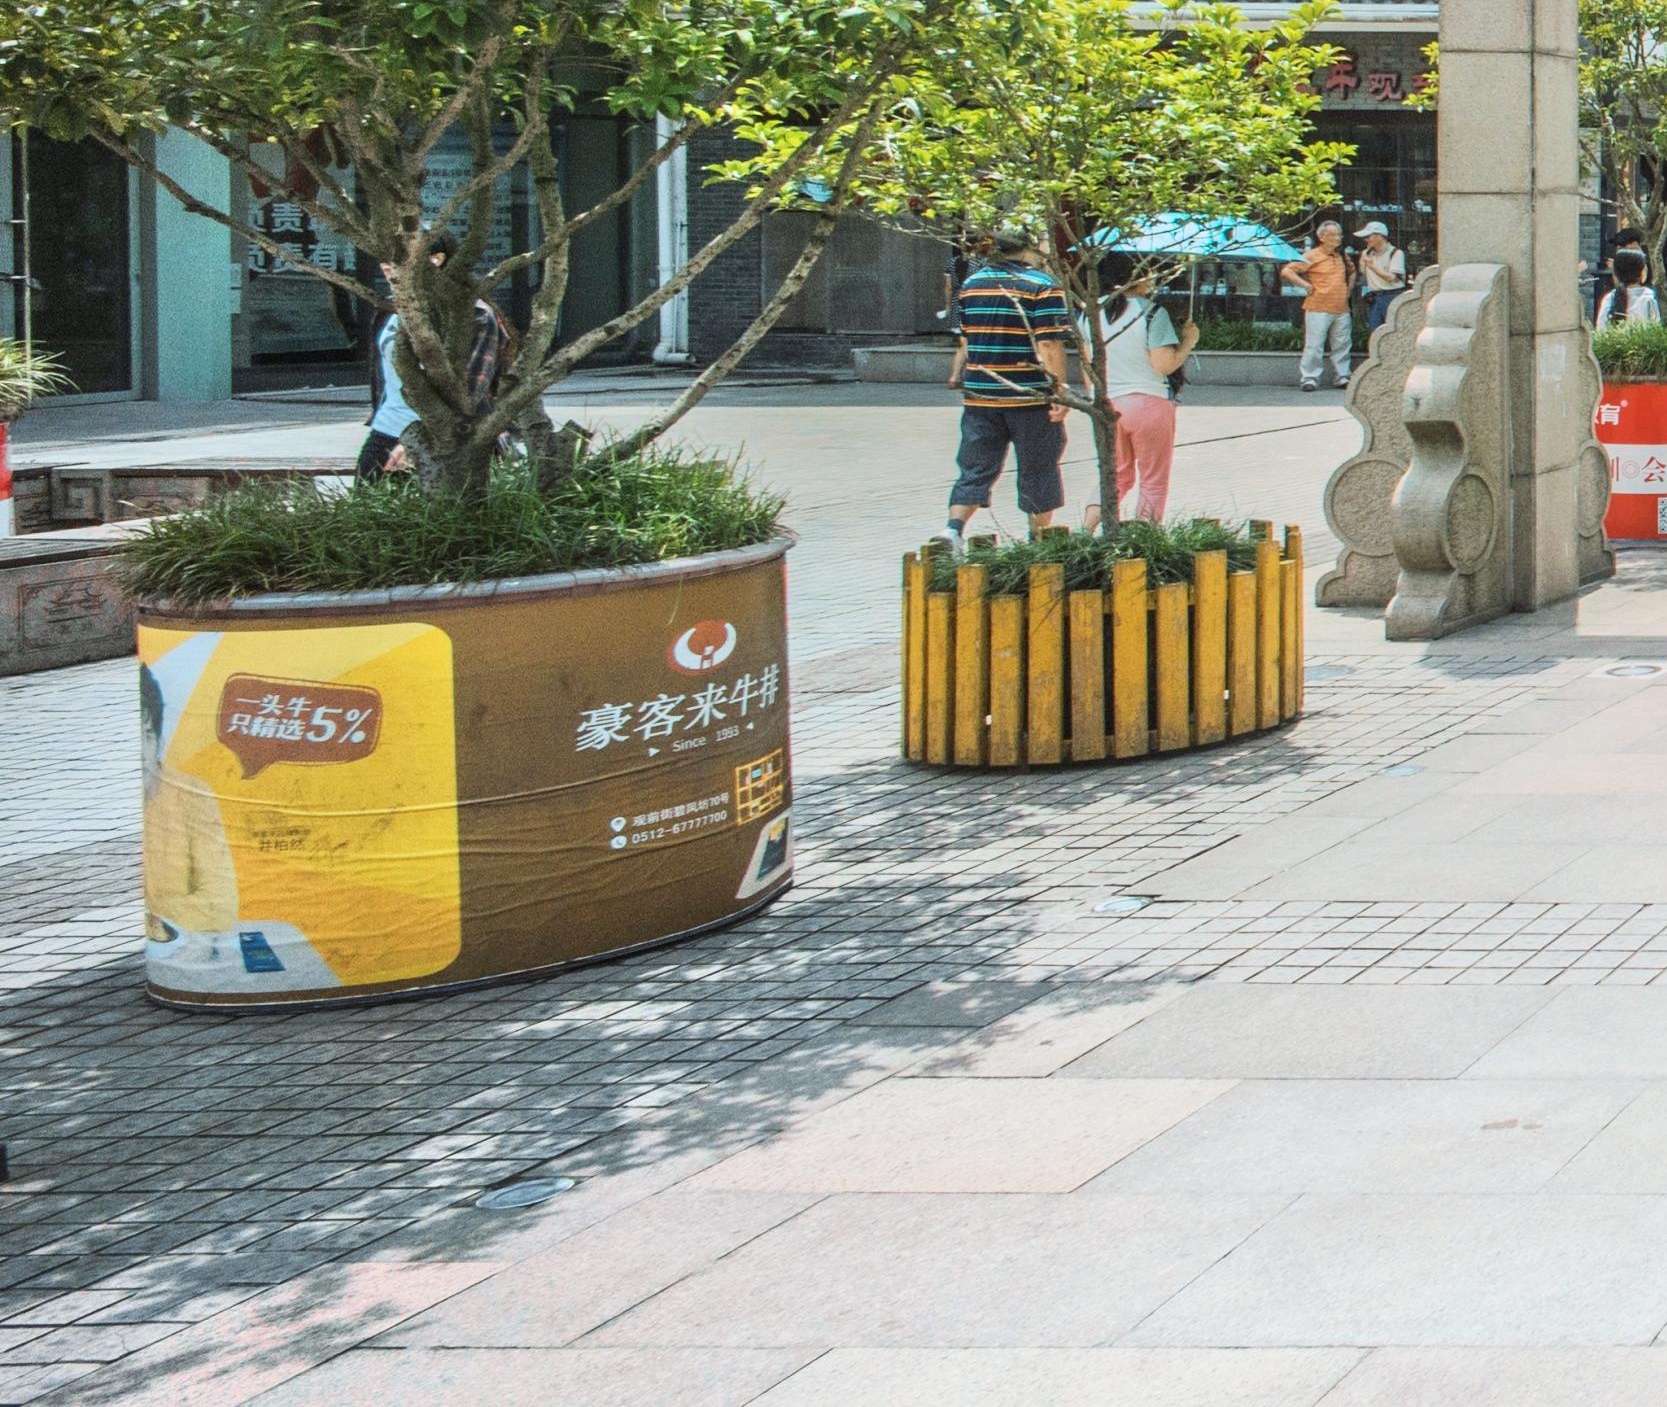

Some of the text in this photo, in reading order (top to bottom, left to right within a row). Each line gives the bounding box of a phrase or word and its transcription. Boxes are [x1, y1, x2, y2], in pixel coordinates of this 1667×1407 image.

[235, 693, 312, 718] 一头牛
[575, 663, 780, 752] 豪客来牛排
[227, 706, 373, 745] 只精选 5%
[672, 725, 740, 753] Since 1993
[631, 809, 728, 844] 0512-67777700
